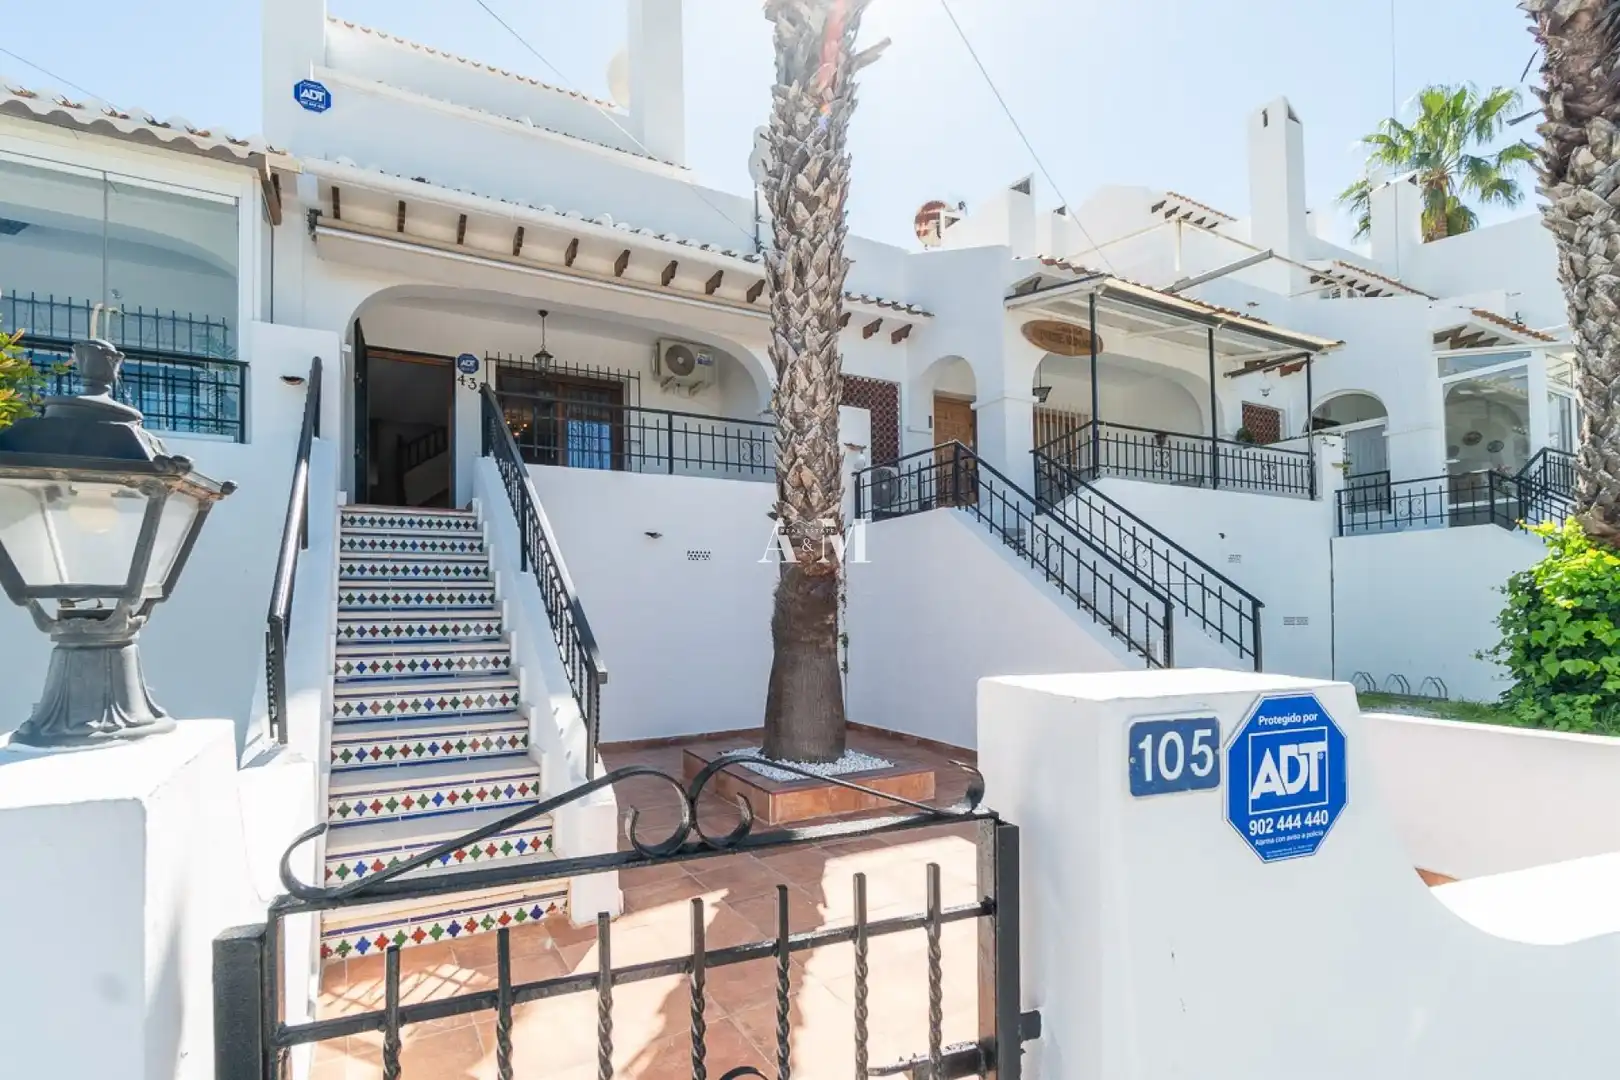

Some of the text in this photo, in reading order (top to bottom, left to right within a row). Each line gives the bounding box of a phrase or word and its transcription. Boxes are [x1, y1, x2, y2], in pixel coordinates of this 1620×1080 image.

[301, 88, 325, 102] ADT
[457, 374, 477, 391] 43
[1258, 712, 1318, 726] Protegido por
[1138, 728, 1214, 782] 105
[1250, 741, 1328, 800] ADT
[1249, 810, 1329, 836] 902 444 440
